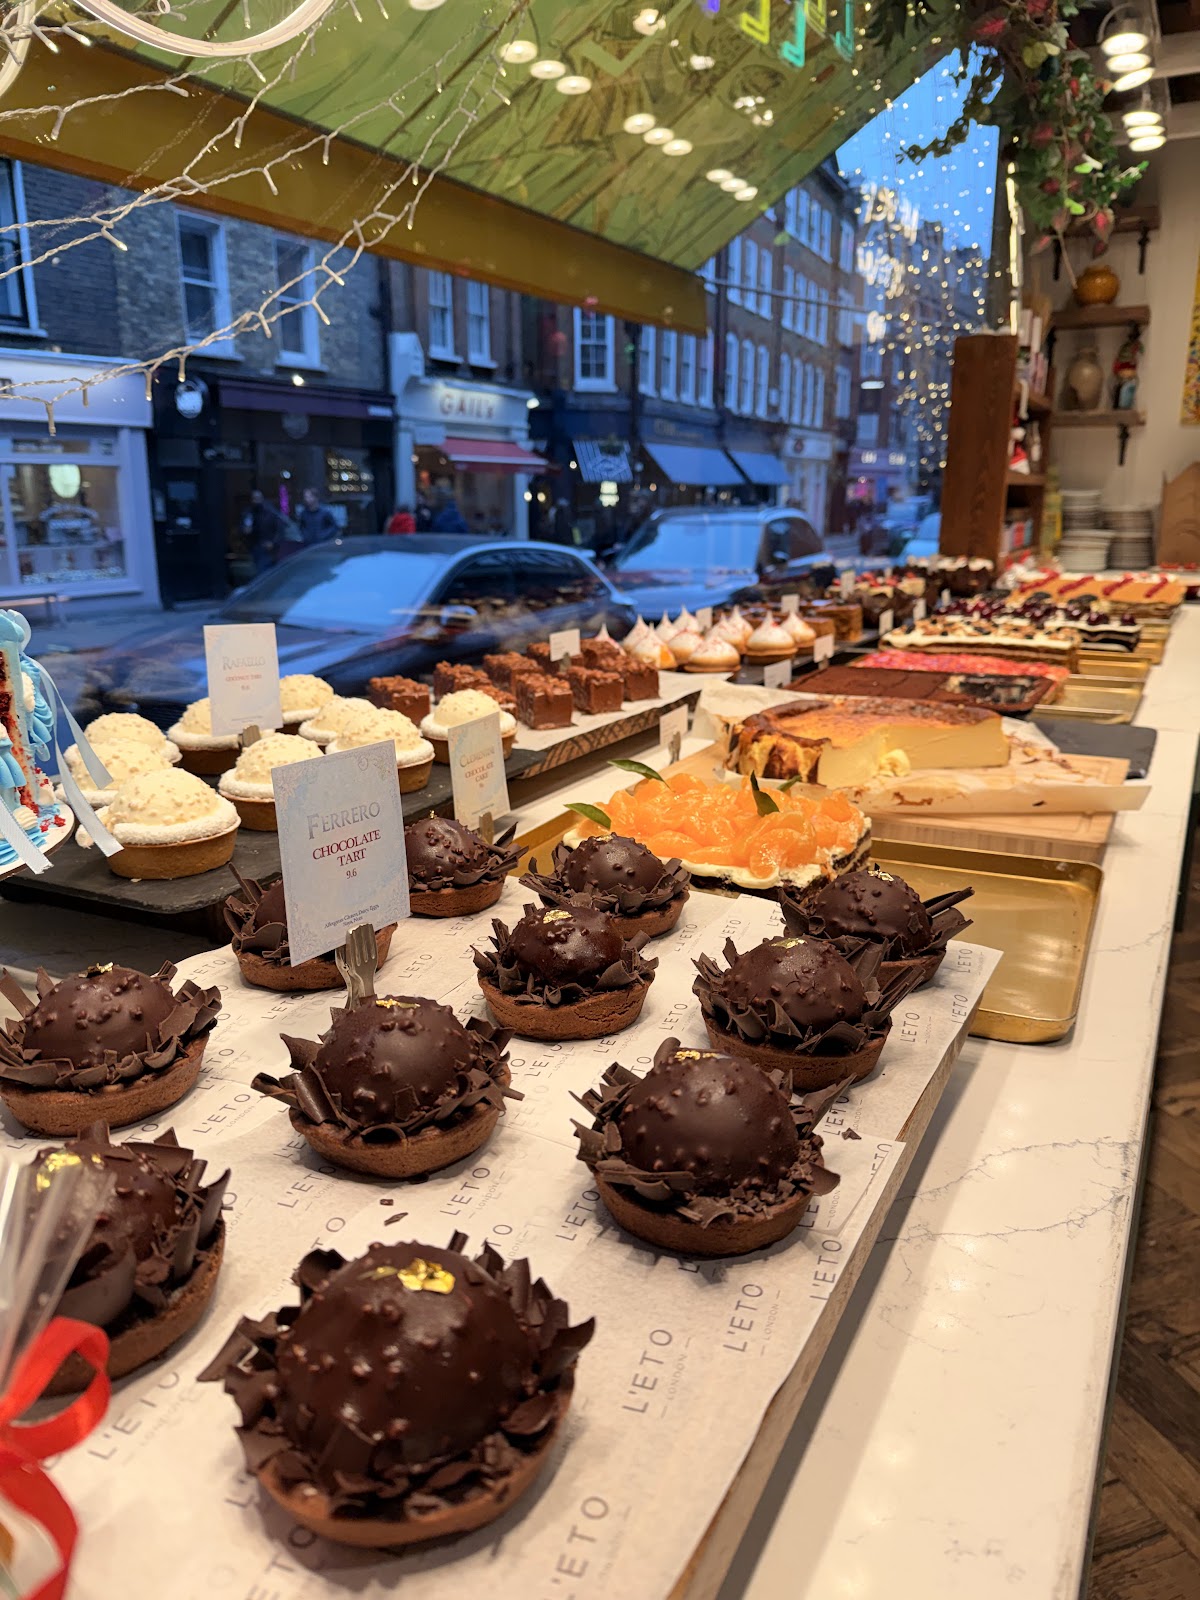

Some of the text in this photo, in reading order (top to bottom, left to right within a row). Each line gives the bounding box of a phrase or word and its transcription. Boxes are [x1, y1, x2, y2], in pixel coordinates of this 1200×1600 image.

[306, 801, 381, 841] FERRERO
[312, 829, 381, 860] CHOCOLATE
[337, 848, 367, 867] TART
[345, 867, 358, 880] 9.6
[398, 953, 433, 979] L'ETO
[261, 994, 304, 1020] L'ETO
[658, 1003, 688, 1031] L'ETO
[900, 1012, 920, 1043] L'ETO
[192, 1094, 251, 1134] L'ETO
[277, 1165, 336, 1208] L'ETO
[440, 1167, 491, 1215] L'ETO
[555, 1190, 601, 1241] L'ETO
[809, 1239, 842, 1301] L'ETO
[722, 1283, 764, 1353] L'ETO
[763, 1303, 780, 1341] LONDON
[621, 1329, 673, 1414] L'ETO
